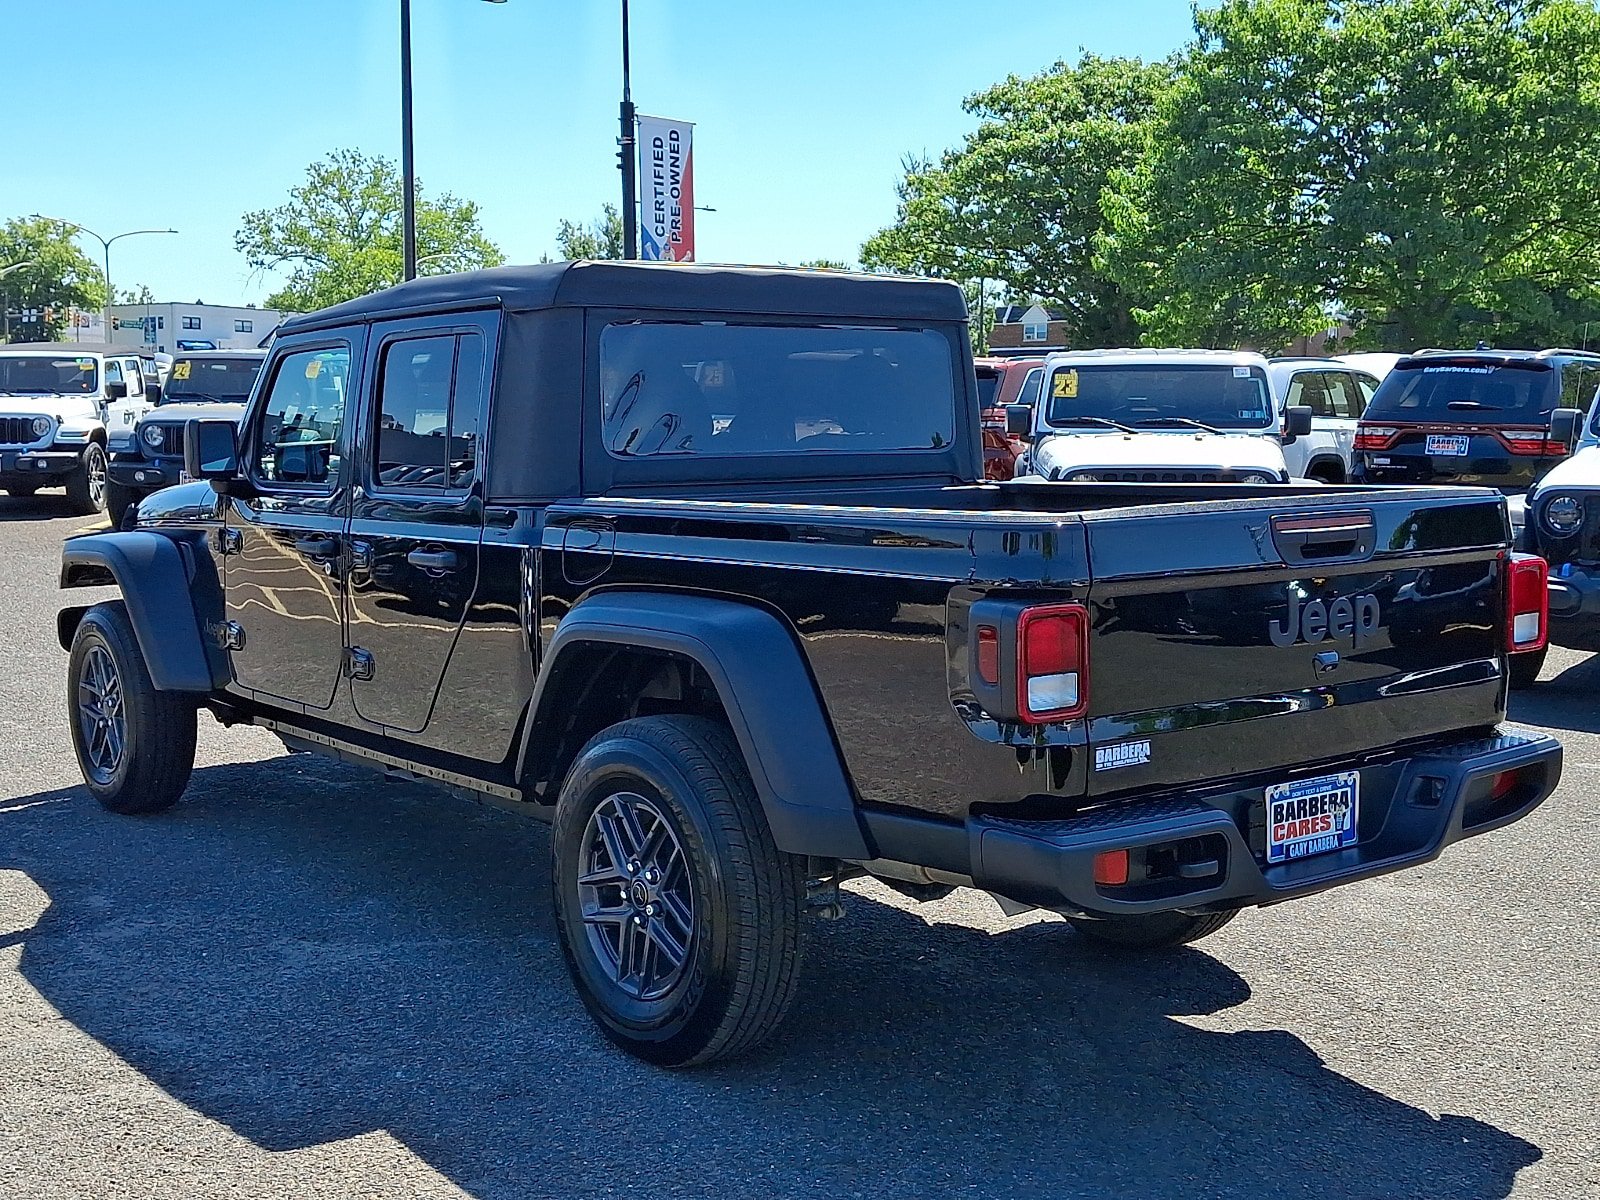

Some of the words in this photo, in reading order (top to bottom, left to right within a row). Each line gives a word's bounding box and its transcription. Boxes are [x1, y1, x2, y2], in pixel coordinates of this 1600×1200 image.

[653, 136, 665, 238] CERTIFIED
[669, 129, 681, 243] PRE-OWNED
[1054, 379, 1077, 396] 23
[1269, 583, 1380, 649] Jeep
[1095, 742, 1151, 764] BARBERA
[1273, 791, 1350, 824] BARBERA
[1273, 814, 1332, 842] CARES
[1289, 841, 1308, 858] GARY
[1308, 834, 1339, 853] BARBERA
